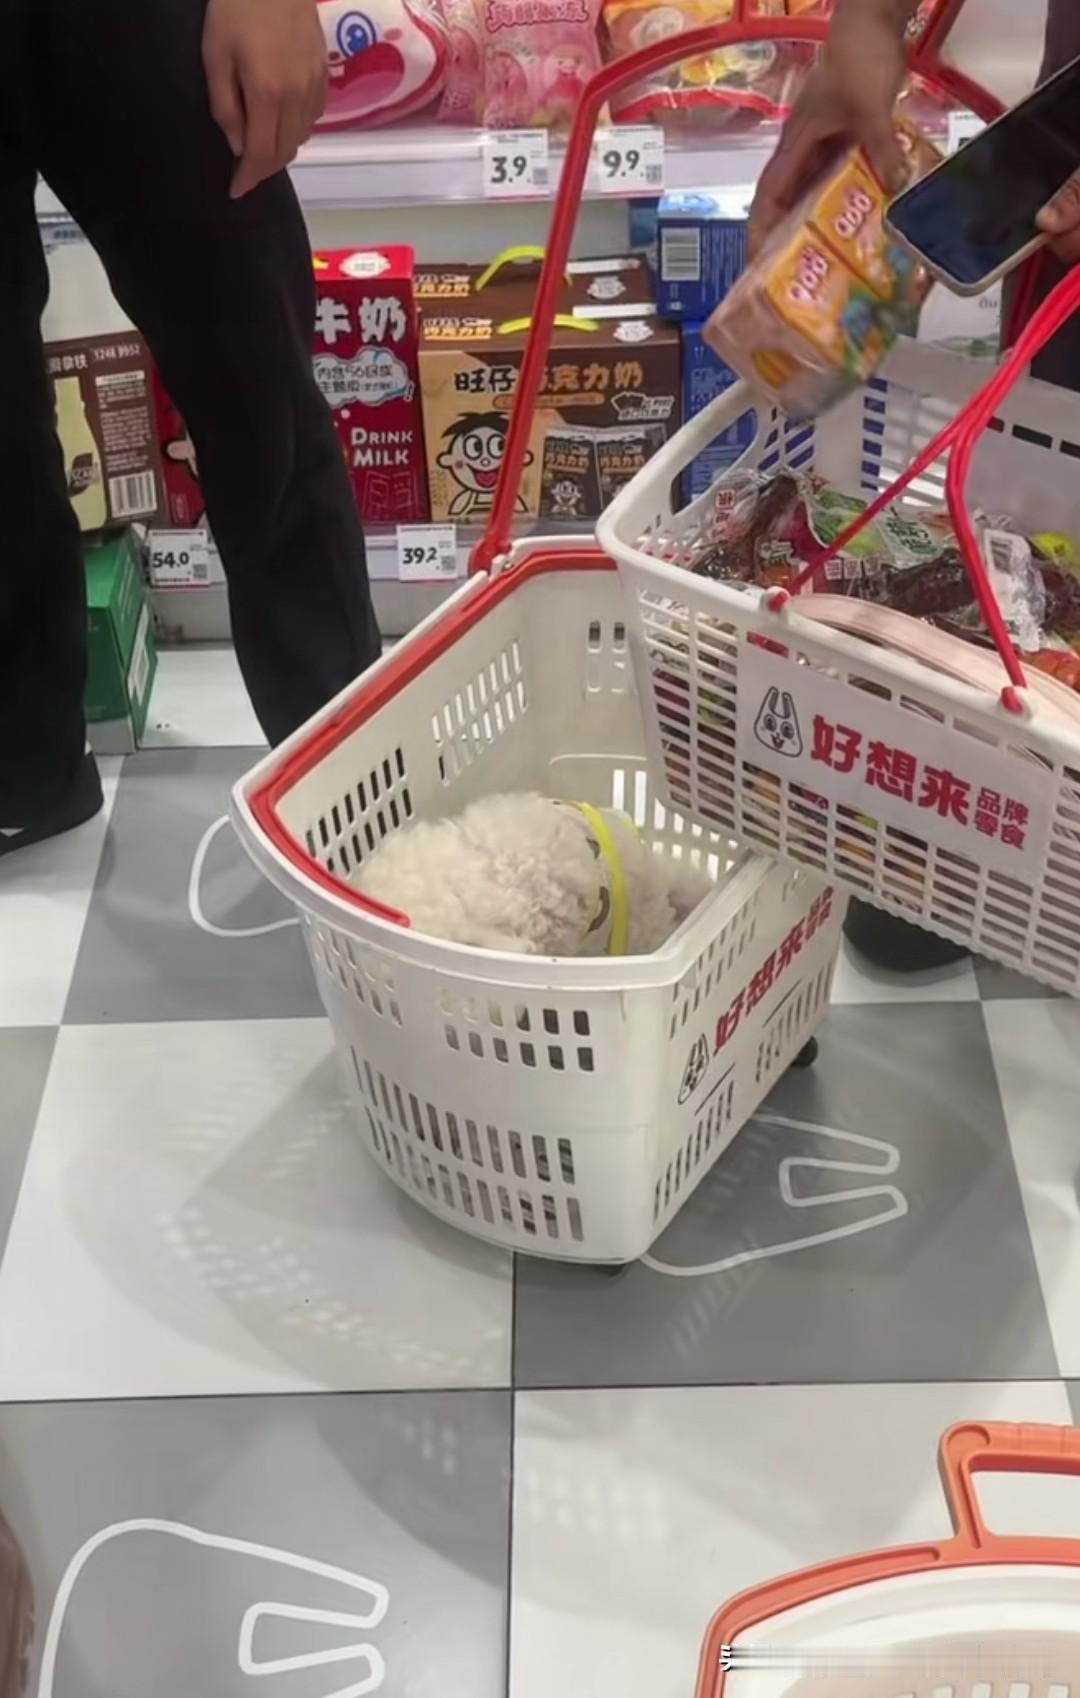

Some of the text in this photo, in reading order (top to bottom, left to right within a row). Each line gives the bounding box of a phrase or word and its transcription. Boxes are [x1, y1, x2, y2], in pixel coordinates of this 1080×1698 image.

[490, 155, 527, 184] 3.9
[602, 149, 640, 178] 9.9
[314, 297, 407, 343] 牛奶
[351, 426, 413, 445] DRINK
[353, 449, 409, 467] MILK
[152, 551, 190, 569] 54.0
[810, 714, 971, 826] 好想来
[977, 786, 1029, 826] 品牌
[974, 809, 1026, 850] 零食
